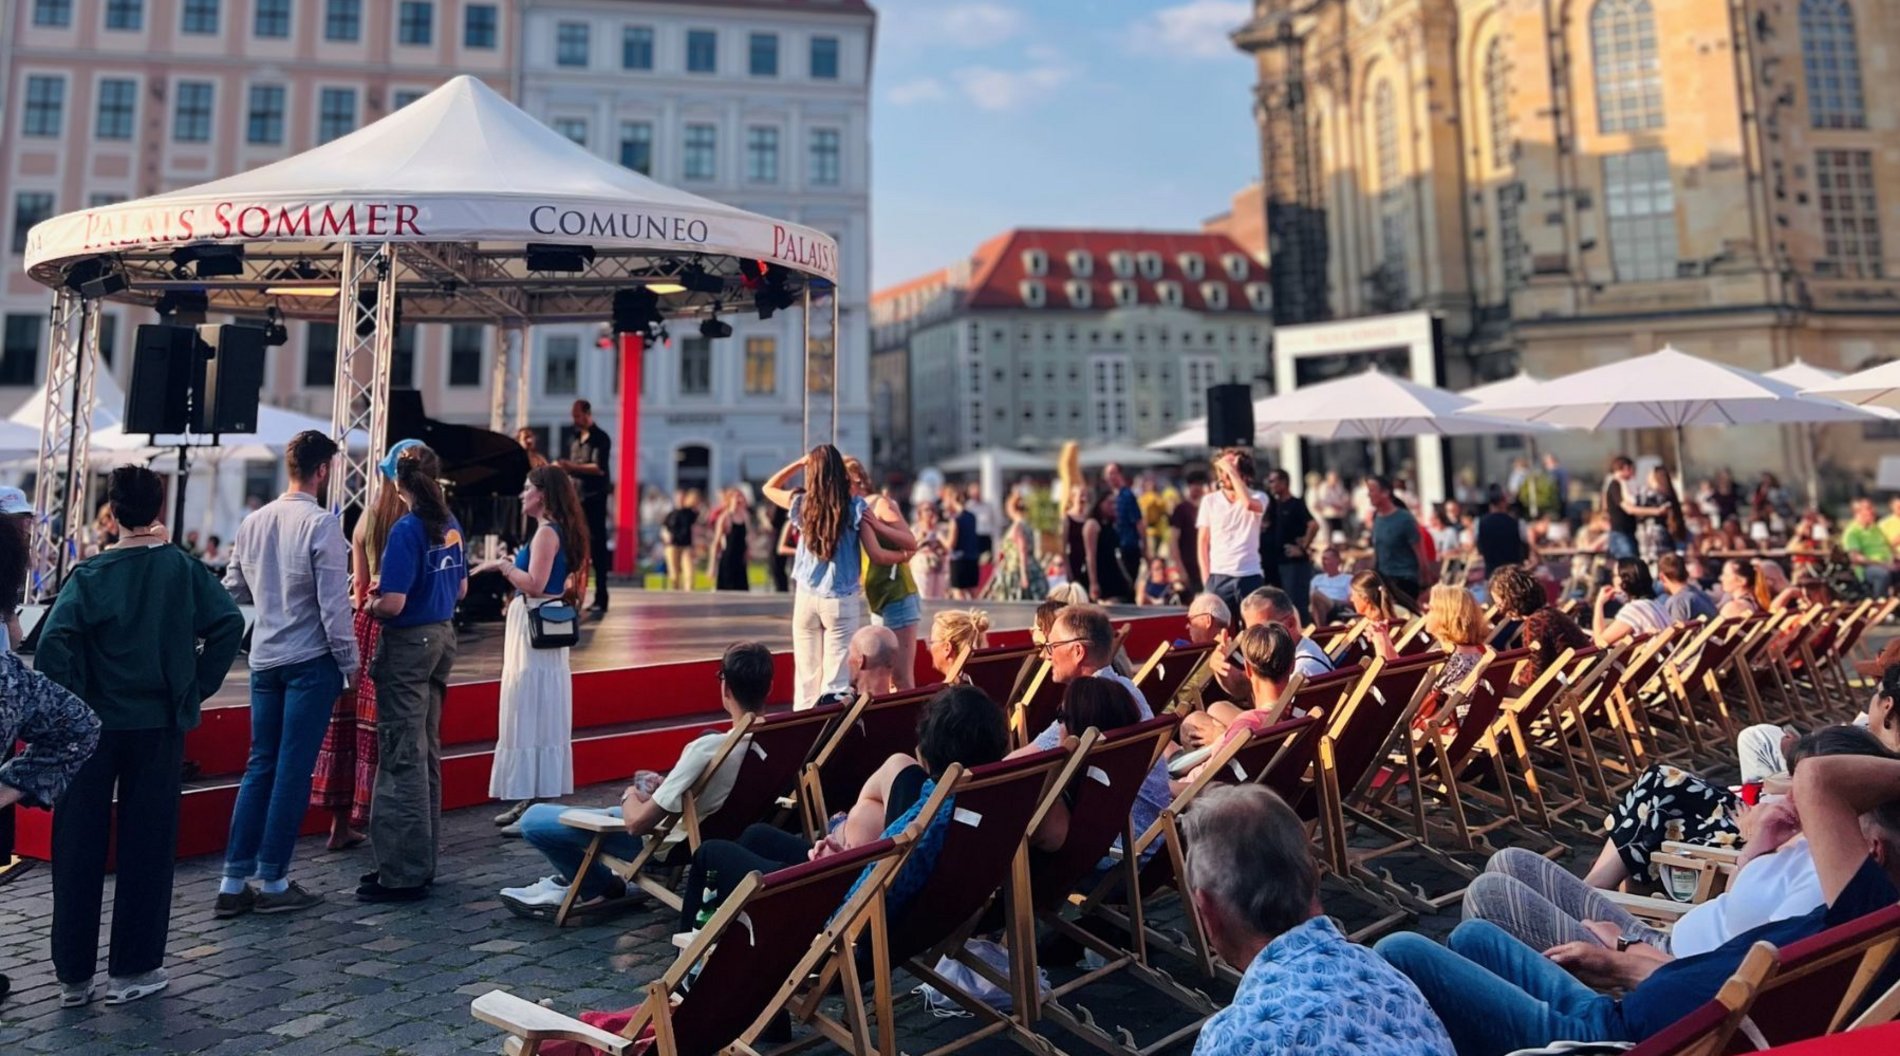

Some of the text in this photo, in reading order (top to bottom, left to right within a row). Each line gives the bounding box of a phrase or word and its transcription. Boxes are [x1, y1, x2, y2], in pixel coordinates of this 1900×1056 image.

[211, 201, 426, 239] SOMMER
[529, 205, 708, 243] COMUNEO
[772, 224, 830, 272] PALAIS
